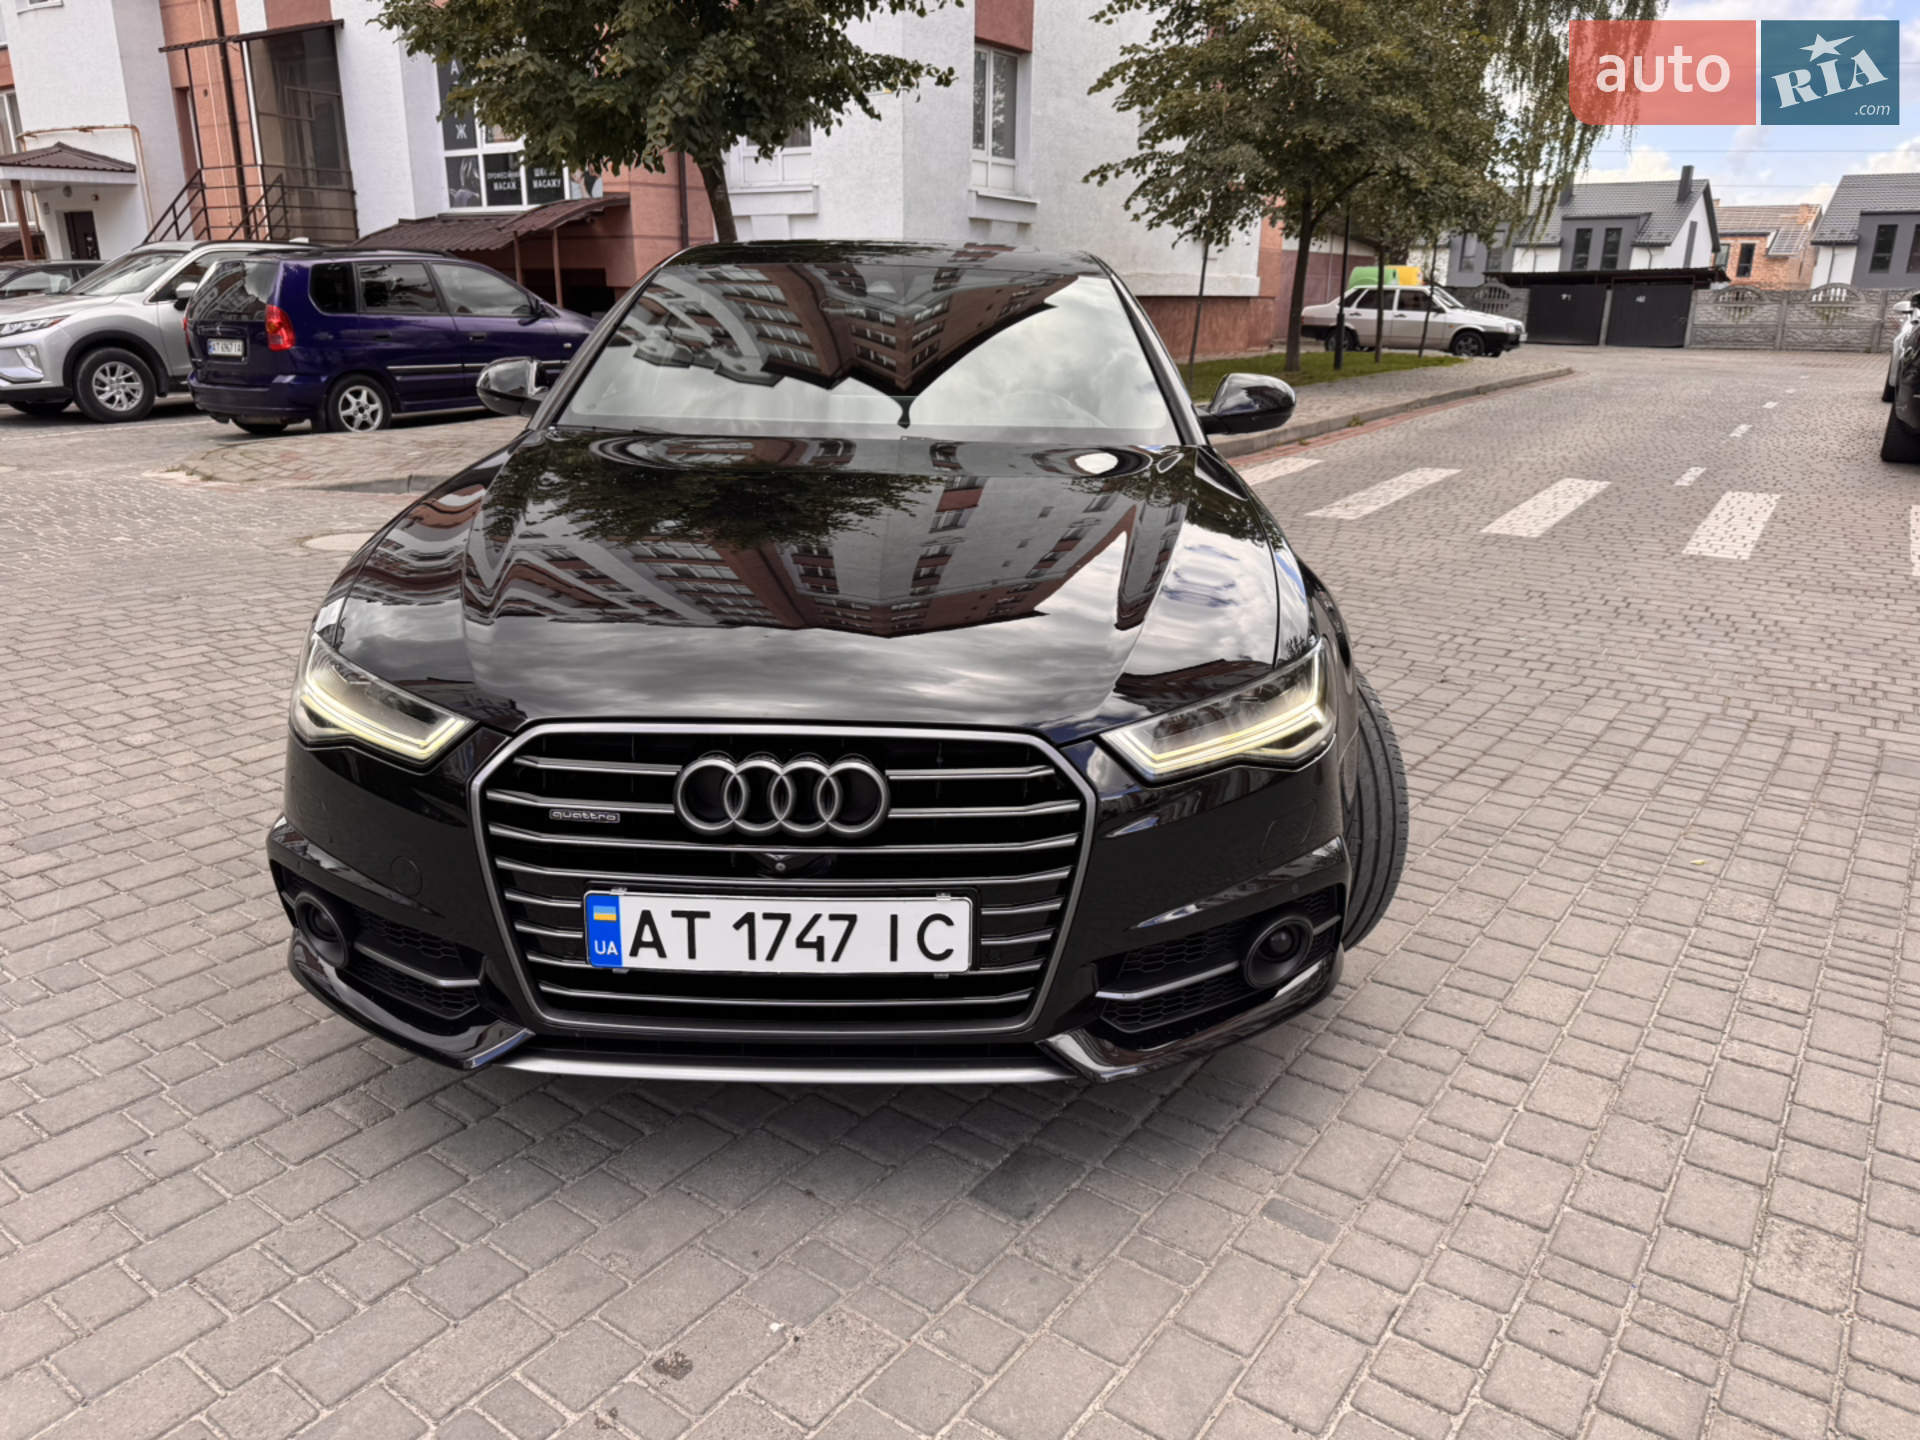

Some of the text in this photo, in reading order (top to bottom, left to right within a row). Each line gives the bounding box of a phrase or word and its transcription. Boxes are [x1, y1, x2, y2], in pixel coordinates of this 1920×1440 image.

[493, 181, 517, 191] МАСАЖ
[532, 178, 561, 189] МАСАЖУ
[552, 810, 616, 821] quattro
[629, 909, 955, 962] AT 1747 IC
[594, 940, 619, 956] UA
